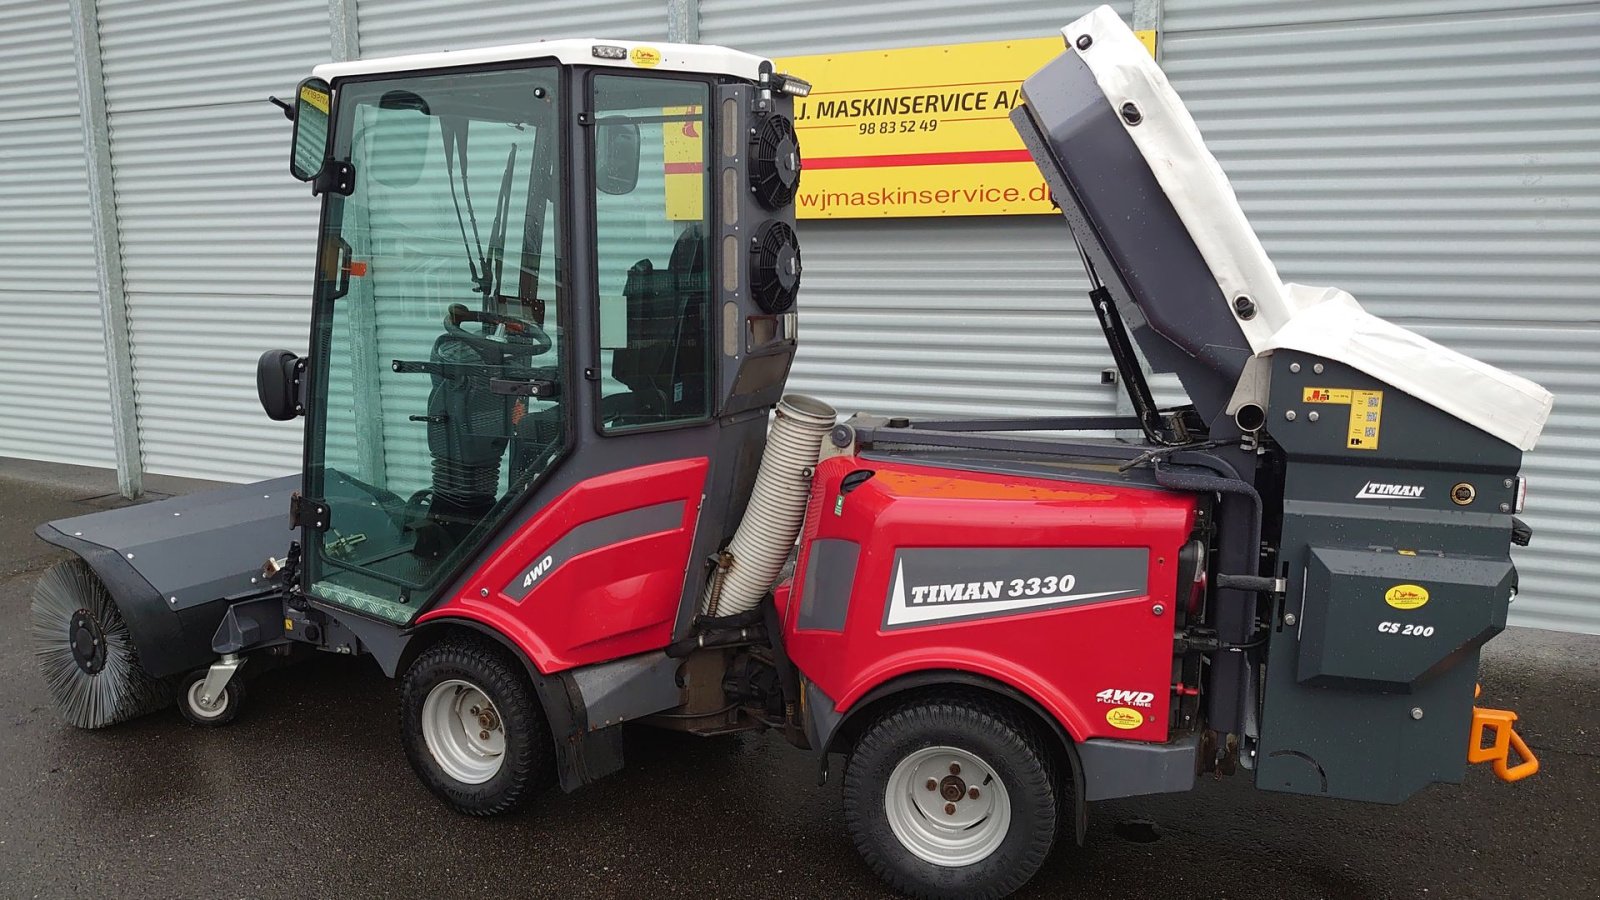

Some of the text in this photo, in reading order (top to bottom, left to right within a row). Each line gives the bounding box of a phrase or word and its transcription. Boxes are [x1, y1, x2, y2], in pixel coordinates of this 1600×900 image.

[816, 91, 989, 119] MASKINSERVICE
[994, 89, 1022, 110] A/
[859, 119, 938, 135] 98 83 52 49
[1368, 483, 1425, 497] TIMAN
[523, 555, 553, 588] 4WD
[911, 574, 1076, 604] TIMAN 3330
[1378, 621, 1435, 637] CS 200
[1096, 688, 1155, 704] 4WD
